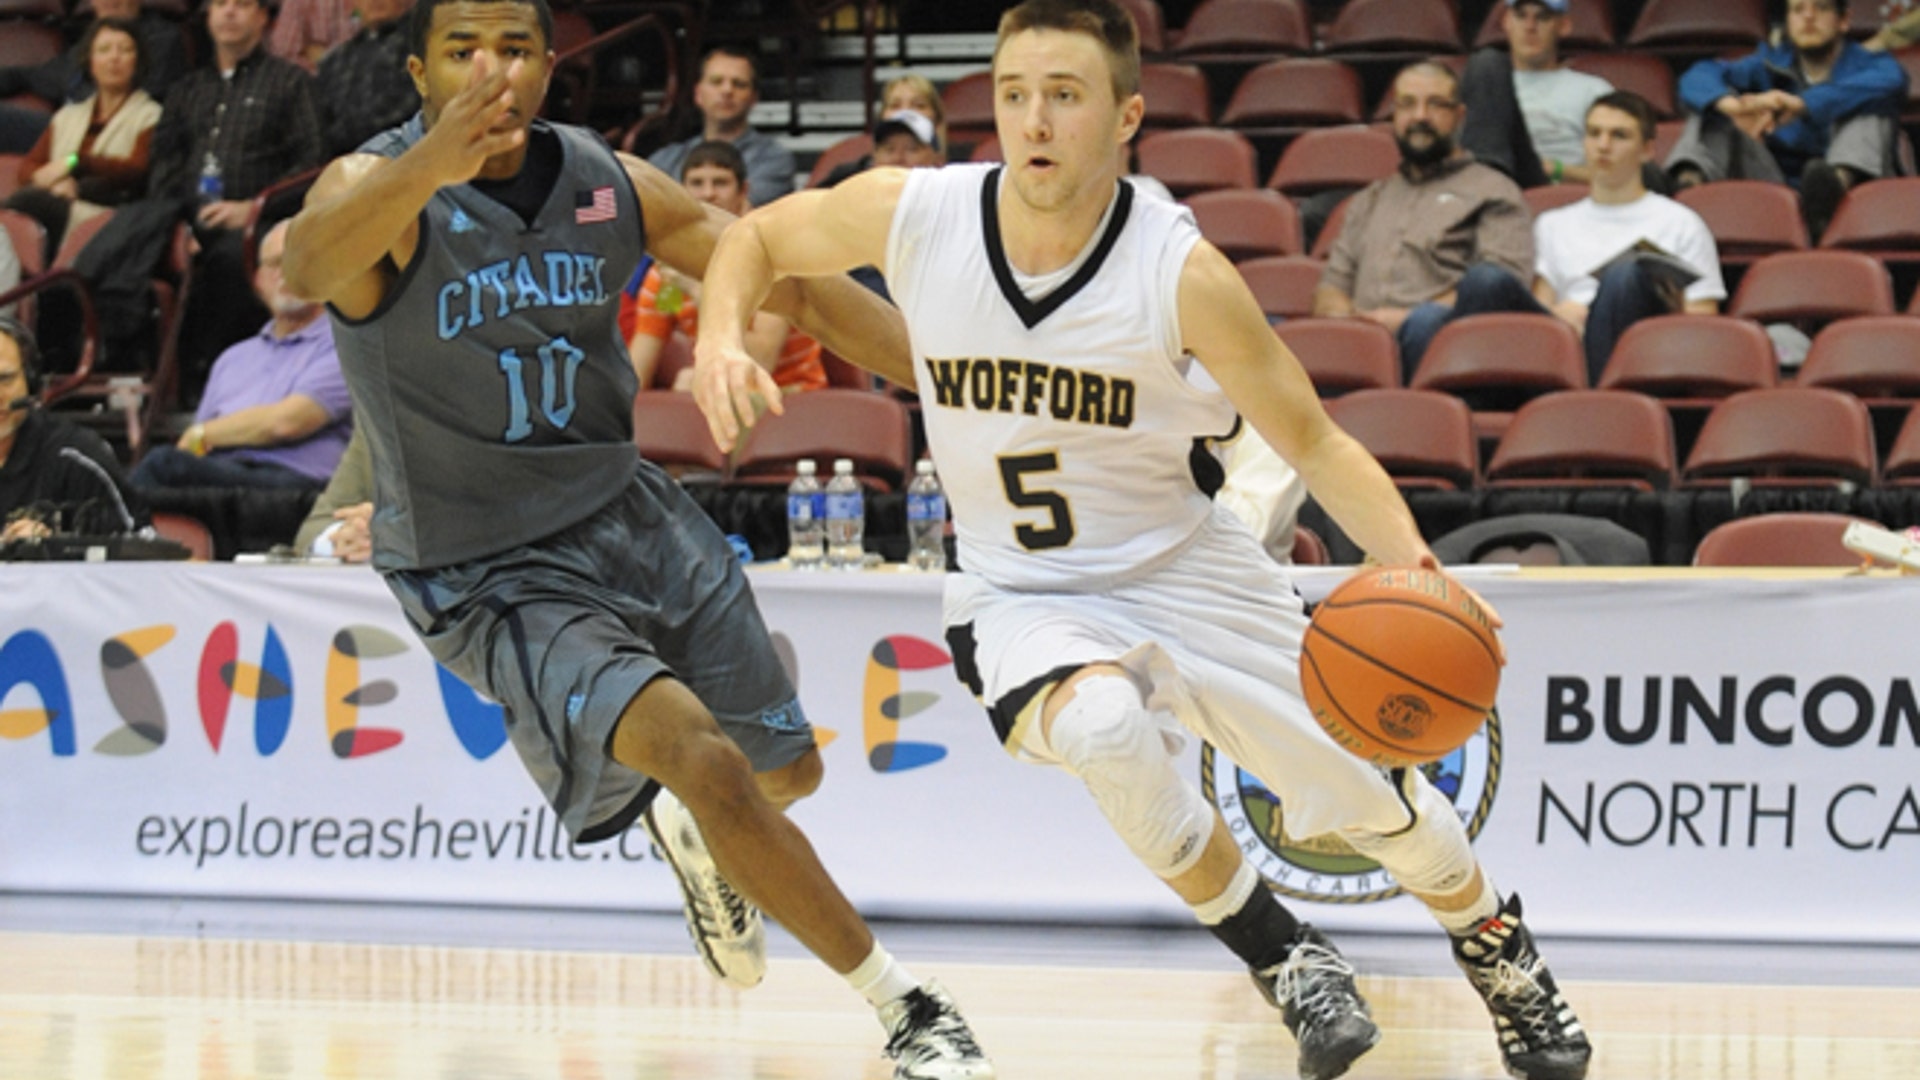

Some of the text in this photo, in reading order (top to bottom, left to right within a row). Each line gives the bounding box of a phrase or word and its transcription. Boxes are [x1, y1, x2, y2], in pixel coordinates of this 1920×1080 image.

[437, 252, 609, 341] CITADEL
[499, 336, 586, 443] 10
[924, 356, 1136, 430] WOFFORD
[995, 449, 1078, 553] 5
[1221, 792, 1292, 882] NORTH
[1536, 779, 1920, 851] NORTH CA
